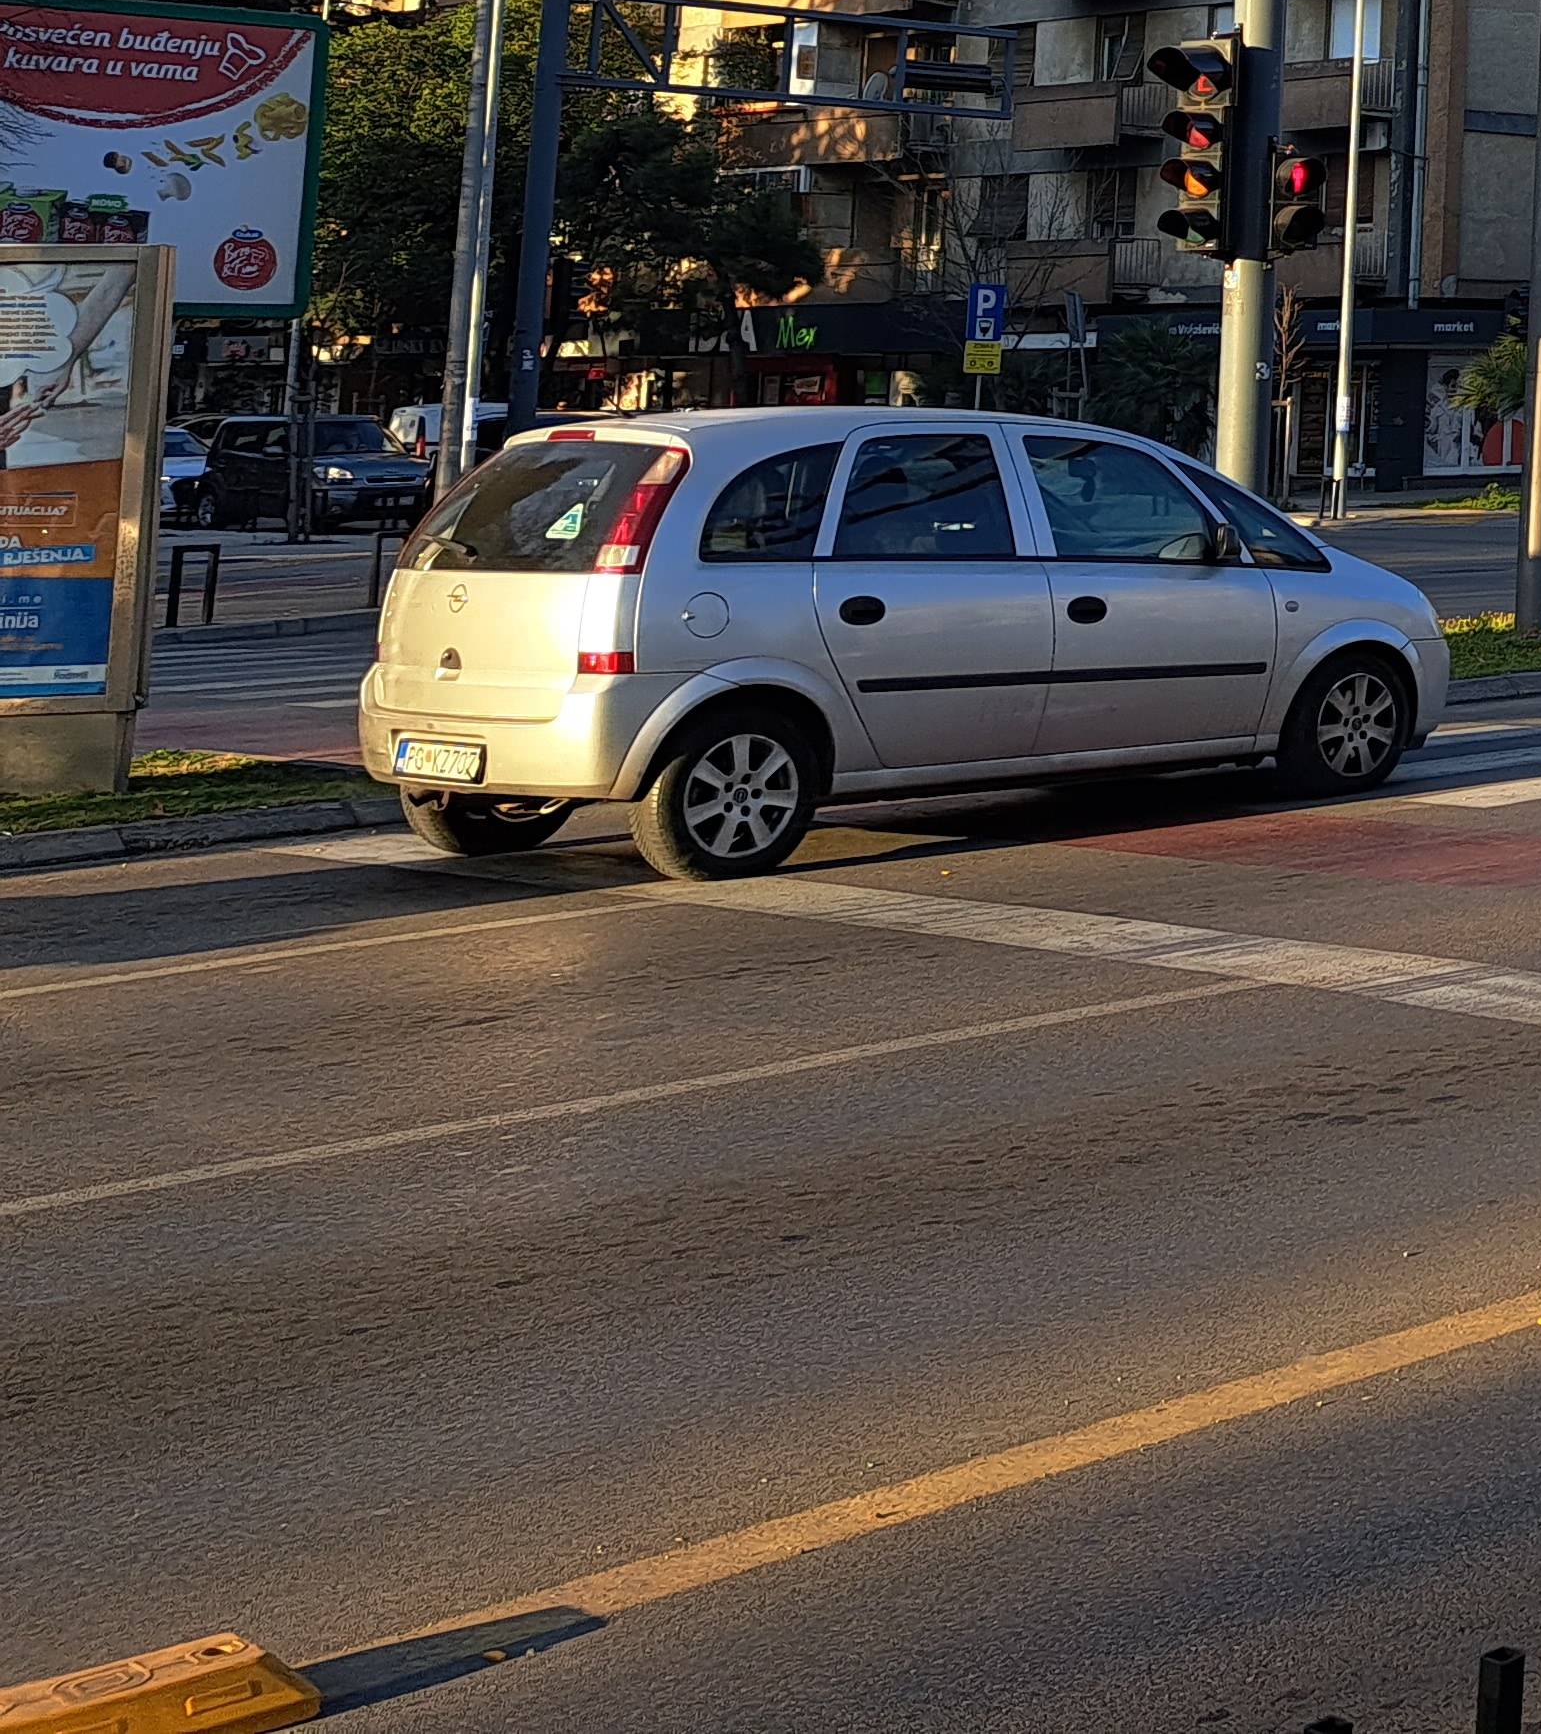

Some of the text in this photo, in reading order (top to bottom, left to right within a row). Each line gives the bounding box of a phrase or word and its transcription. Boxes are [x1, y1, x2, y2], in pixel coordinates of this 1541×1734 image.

[118, 28, 222, 59] buđenju
[4, 47, 199, 81] kuvara u vama
[91, 198, 122, 208] NOVO
[976, 289, 997, 316] P
[1433, 321, 1474, 332] market
[1255, 362, 1271, 380] 3
